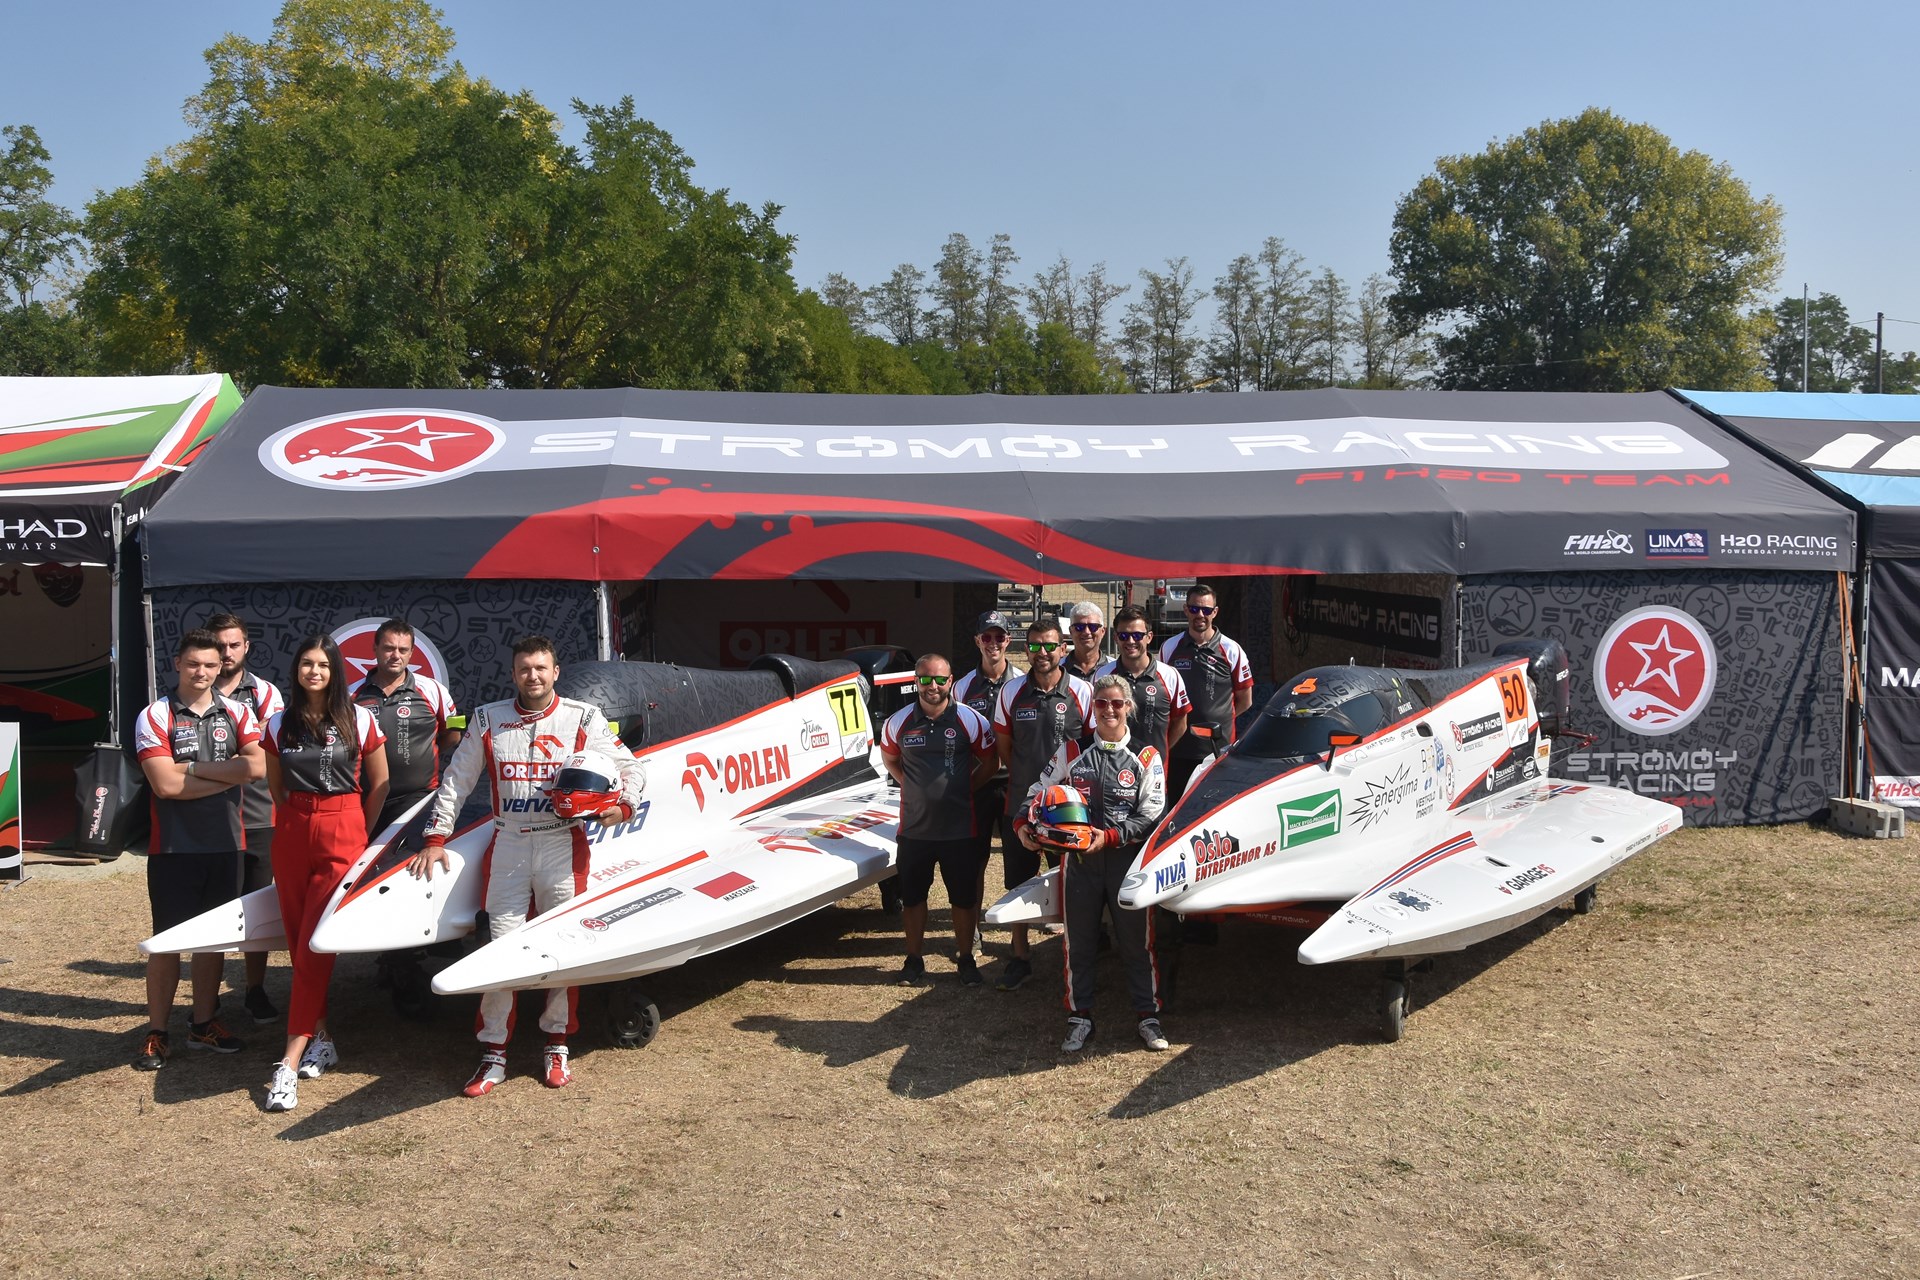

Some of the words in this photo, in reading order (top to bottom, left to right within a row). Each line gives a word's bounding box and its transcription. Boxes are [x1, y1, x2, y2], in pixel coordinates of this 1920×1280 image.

[1227, 431, 1683, 456] RACING
[1296, 471, 1365, 486] F1
[1544, 472, 1730, 486] TEAM
[0, 542, 57, 551] WAYS
[1649, 535, 1683, 548] UIM
[1720, 534, 1761, 547] H2O
[1767, 535, 1837, 549] RACING
[1376, 608, 1438, 641] RACING
[1498, 673, 1525, 719] 50
[829, 687, 860, 732] 77
[812, 733, 829, 747] ORLEN
[503, 763, 562, 779] ORLEN
[725, 744, 791, 795] ORLEN
[1374, 778, 1418, 808] energima
[1588, 772, 1716, 793] RACING
[806, 809, 899, 840] ORLEN
[1194, 832, 1233, 864] Oslo
[1263, 840, 1277, 858] AS
[1155, 860, 1187, 894] NIVA
[1407, 887, 1444, 906] WORLD
[1346, 909, 1394, 936] MOTRICE
